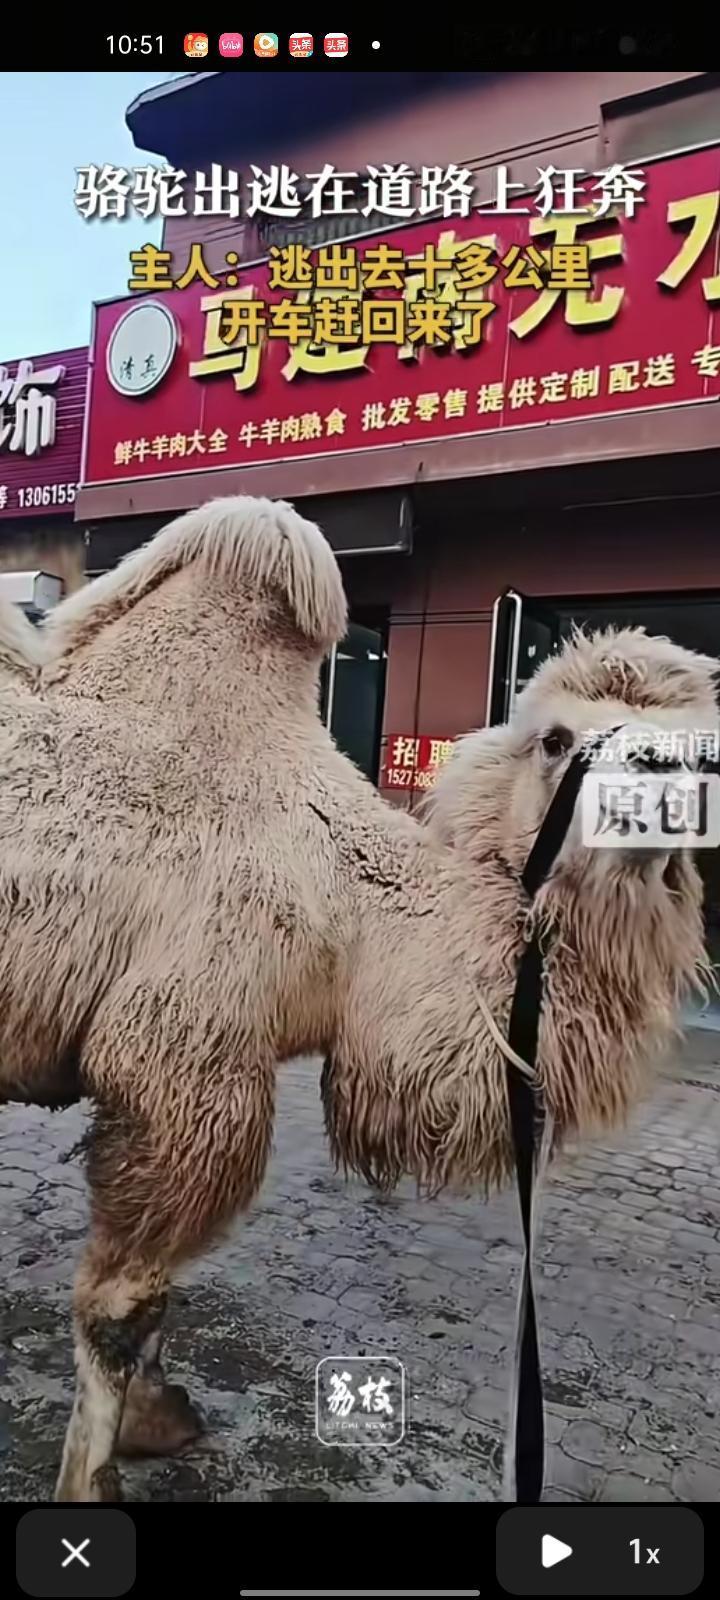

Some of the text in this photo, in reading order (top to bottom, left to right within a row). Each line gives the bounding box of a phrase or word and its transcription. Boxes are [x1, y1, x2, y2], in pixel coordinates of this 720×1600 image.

[106, 35, 163, 54] 10:51
[291, 39, 312, 51] 头条
[326, 40, 347, 51] 头条
[120, 354, 158, 380] 清真
[114, 428, 229, 465] 鲜牛羊肉大全
[238, 407, 347, 448] 牛羊肉熟食
[361, 388, 468, 432] 批发零售
[477, 365, 600, 414] 提供定制
[608, 353, 676, 394] 配送
[18, 482, 81, 507] 1306155
[629, 1538, 660, 1564] 1x
